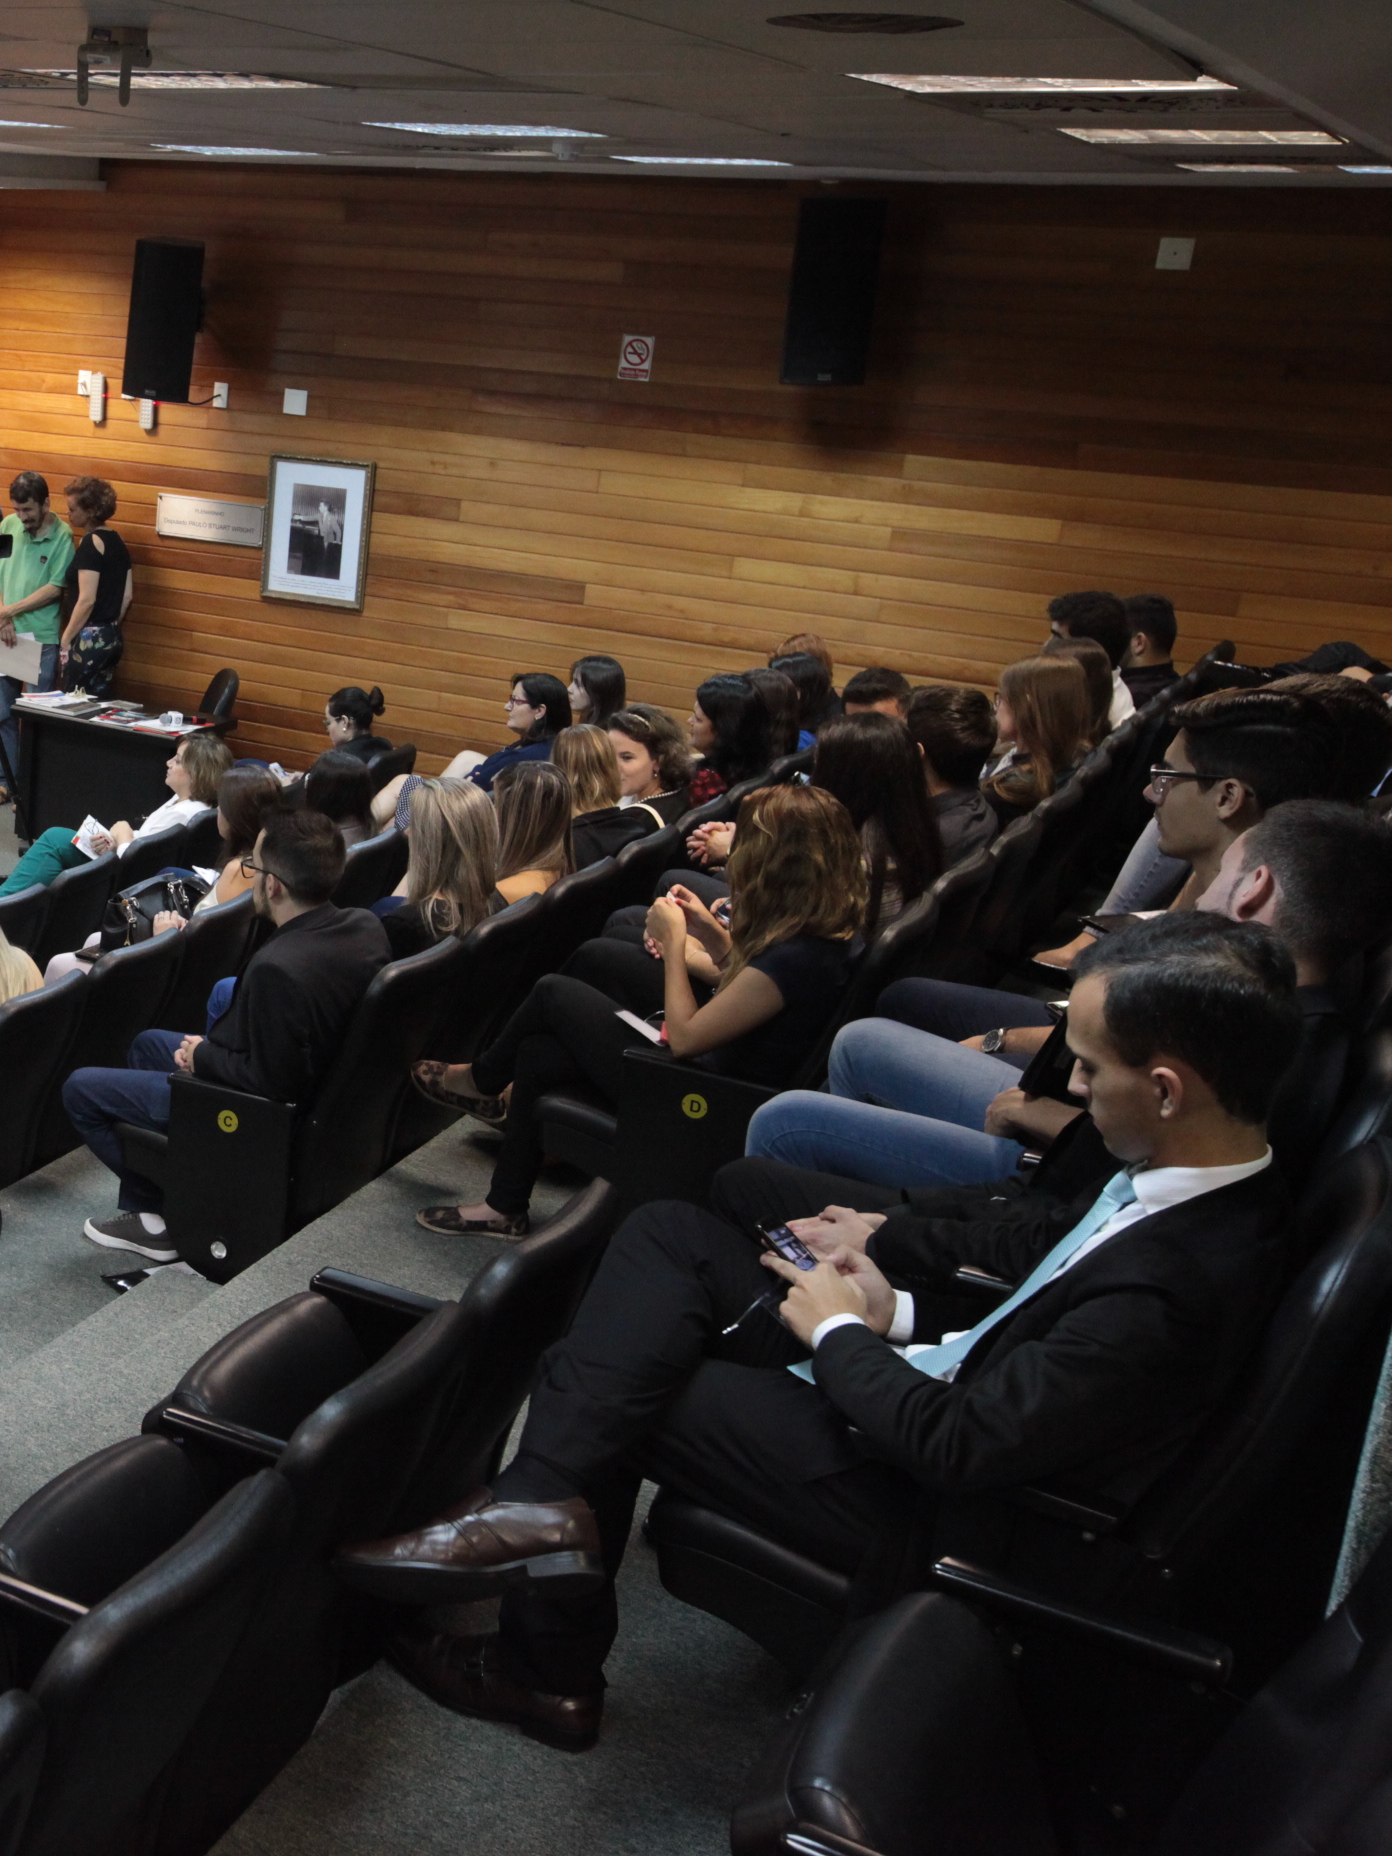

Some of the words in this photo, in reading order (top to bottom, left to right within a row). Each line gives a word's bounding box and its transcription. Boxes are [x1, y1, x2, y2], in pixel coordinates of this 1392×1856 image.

[194, 508, 225, 517] PLENARINHO
[163, 518, 187, 526] Deputado
[188, 520, 207, 528] PAULO
[208, 523, 230, 531] STUART
[231, 526, 255, 534] WRIGHT
[690, 1099, 702, 1113] D
[223, 1115, 233, 1127] C
